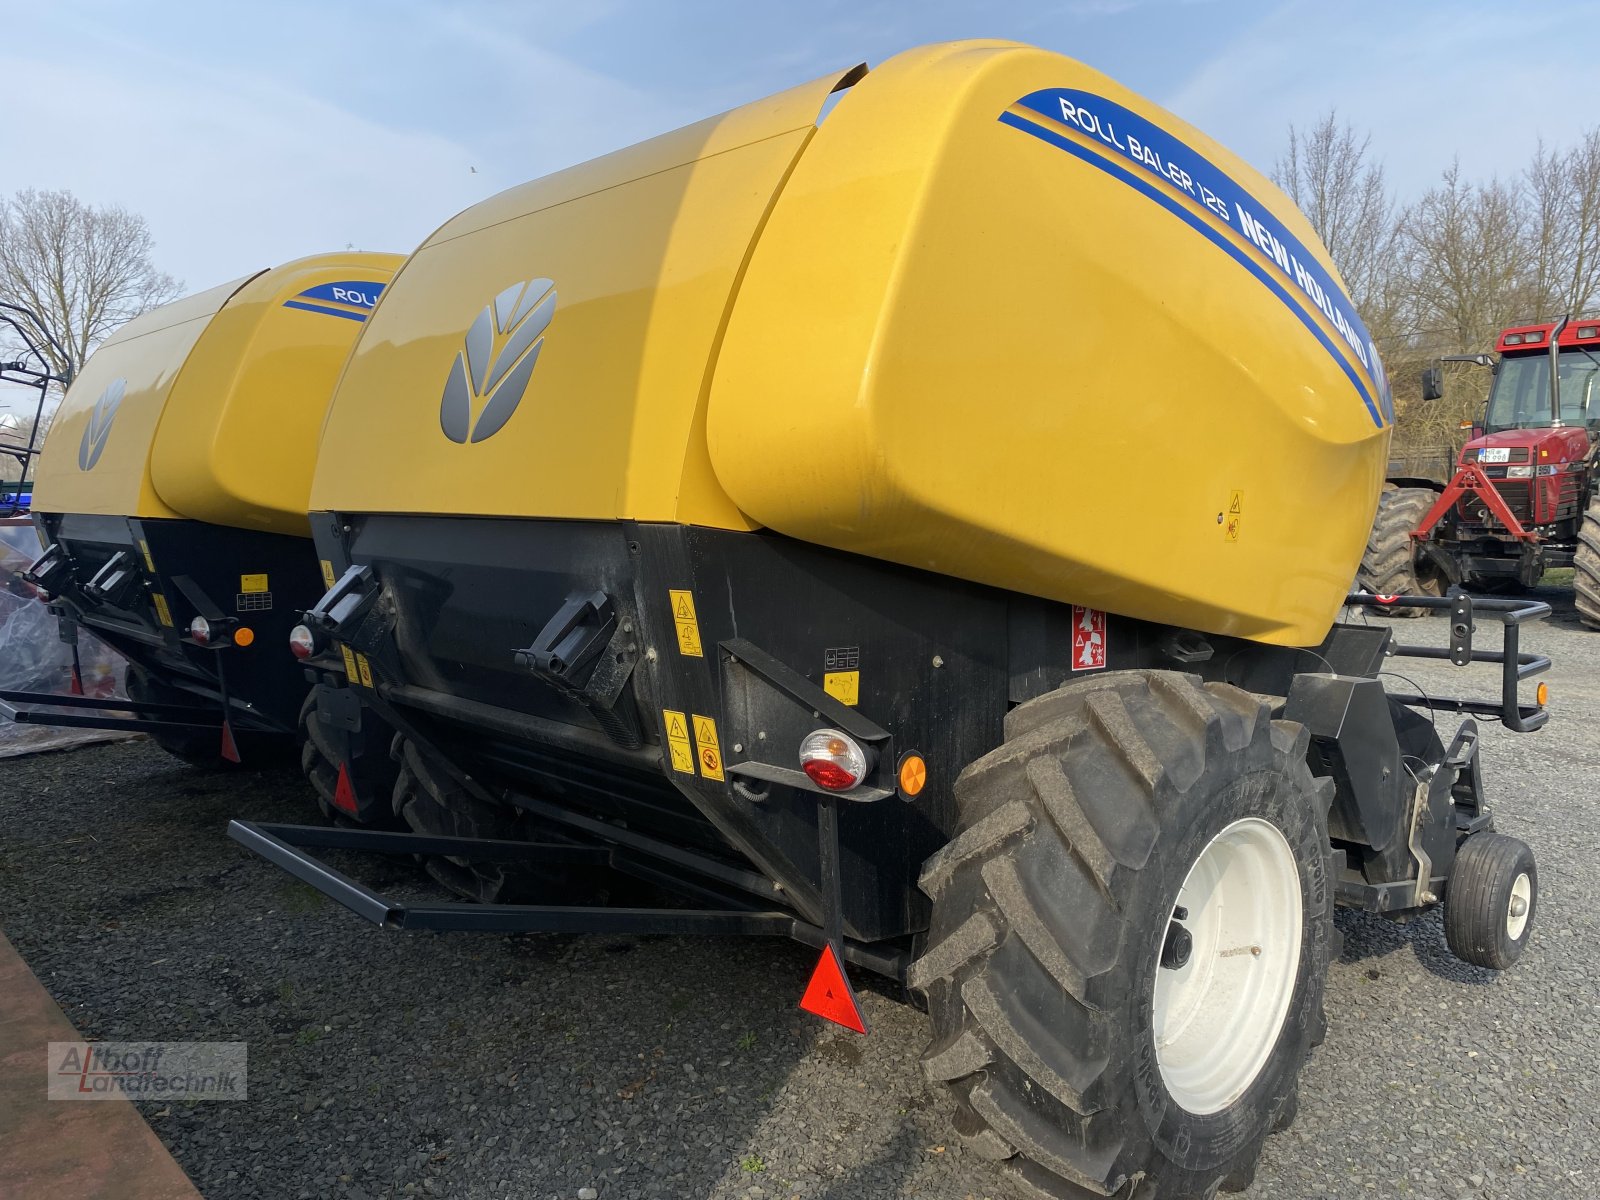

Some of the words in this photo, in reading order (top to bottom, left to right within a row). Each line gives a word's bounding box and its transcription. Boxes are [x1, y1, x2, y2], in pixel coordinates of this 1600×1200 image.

[1059, 97, 1125, 150] ROLL
[1127, 134, 1195, 196] BALER
[1197, 181, 1230, 221] 125
[1235, 202, 1291, 275] NEW
[1291, 254, 1368, 369] HOLLAND
[1308, 842, 1325, 904] apollo
[1138, 1044, 1160, 1114] apollo
